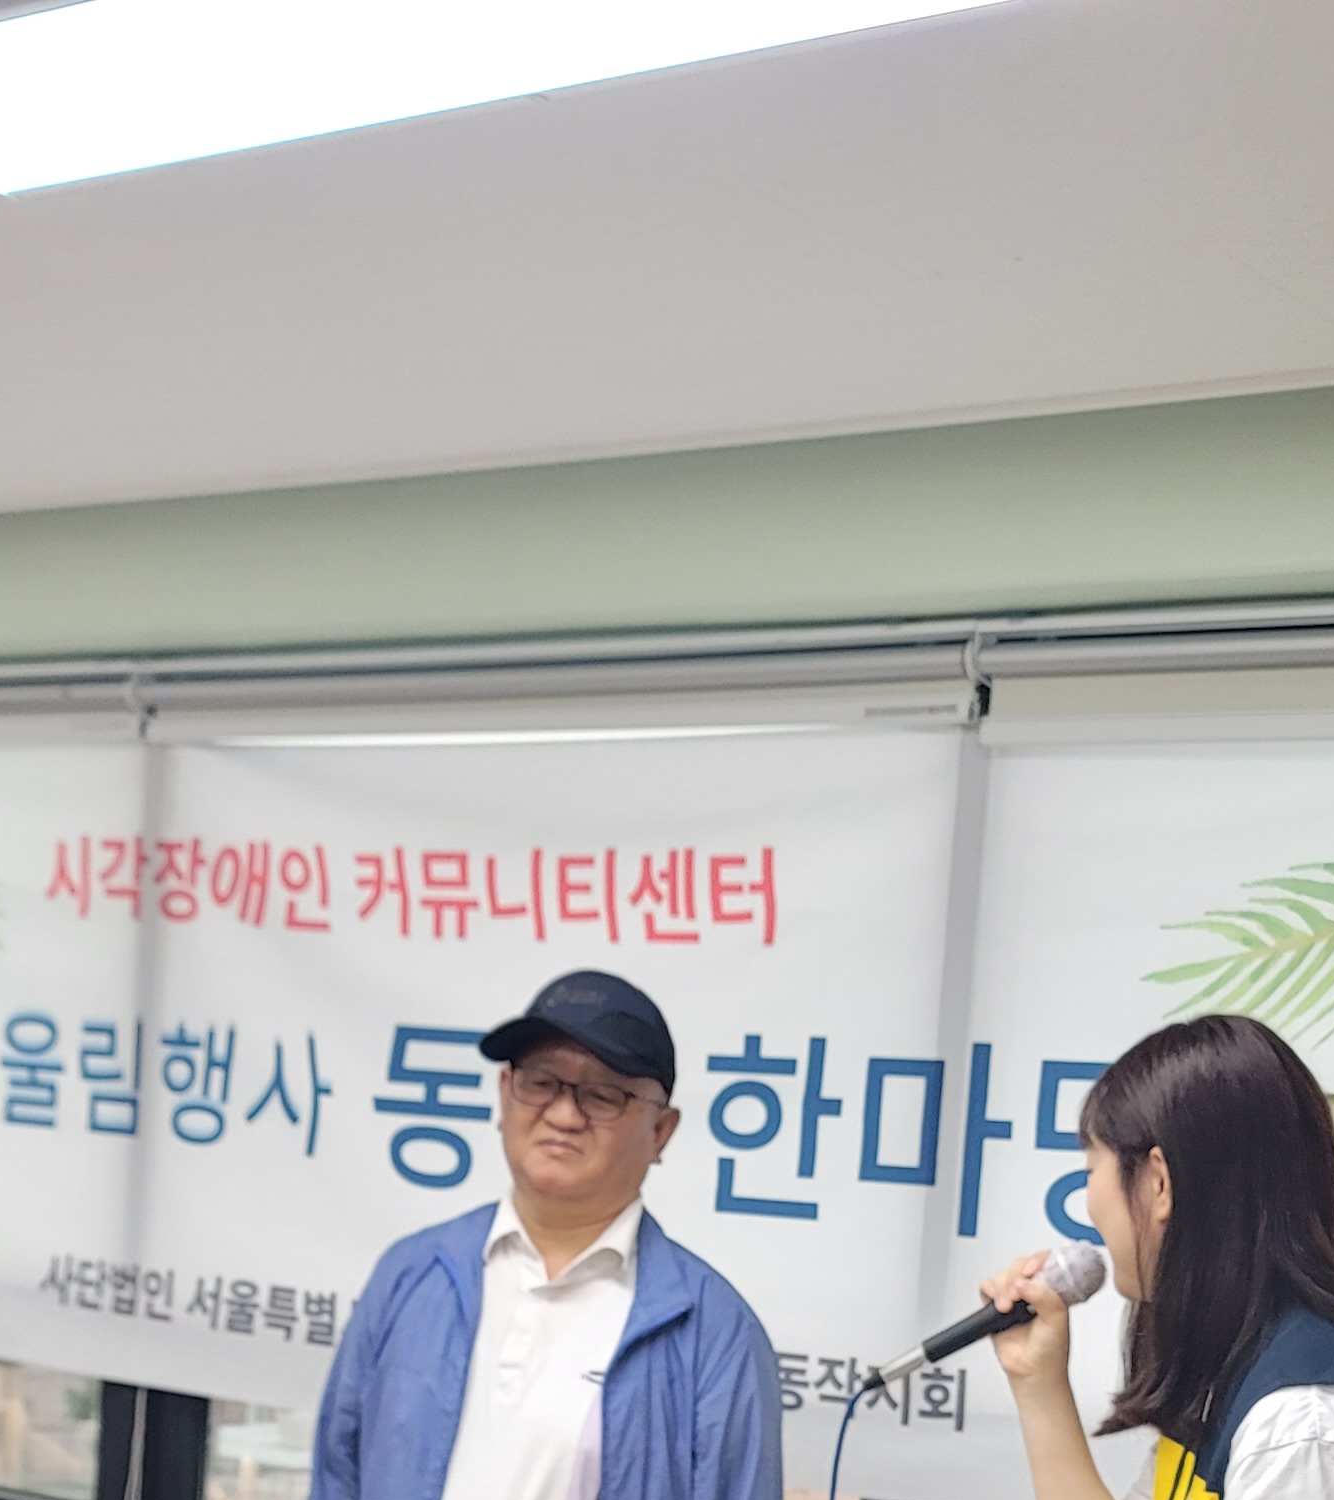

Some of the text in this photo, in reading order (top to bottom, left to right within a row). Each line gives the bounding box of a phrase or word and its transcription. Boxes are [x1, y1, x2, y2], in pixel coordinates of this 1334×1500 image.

[45, 834, 777, 946] 시각장애인 커뮤니티센터
[40, 1253, 174, 1323] 사단법인
